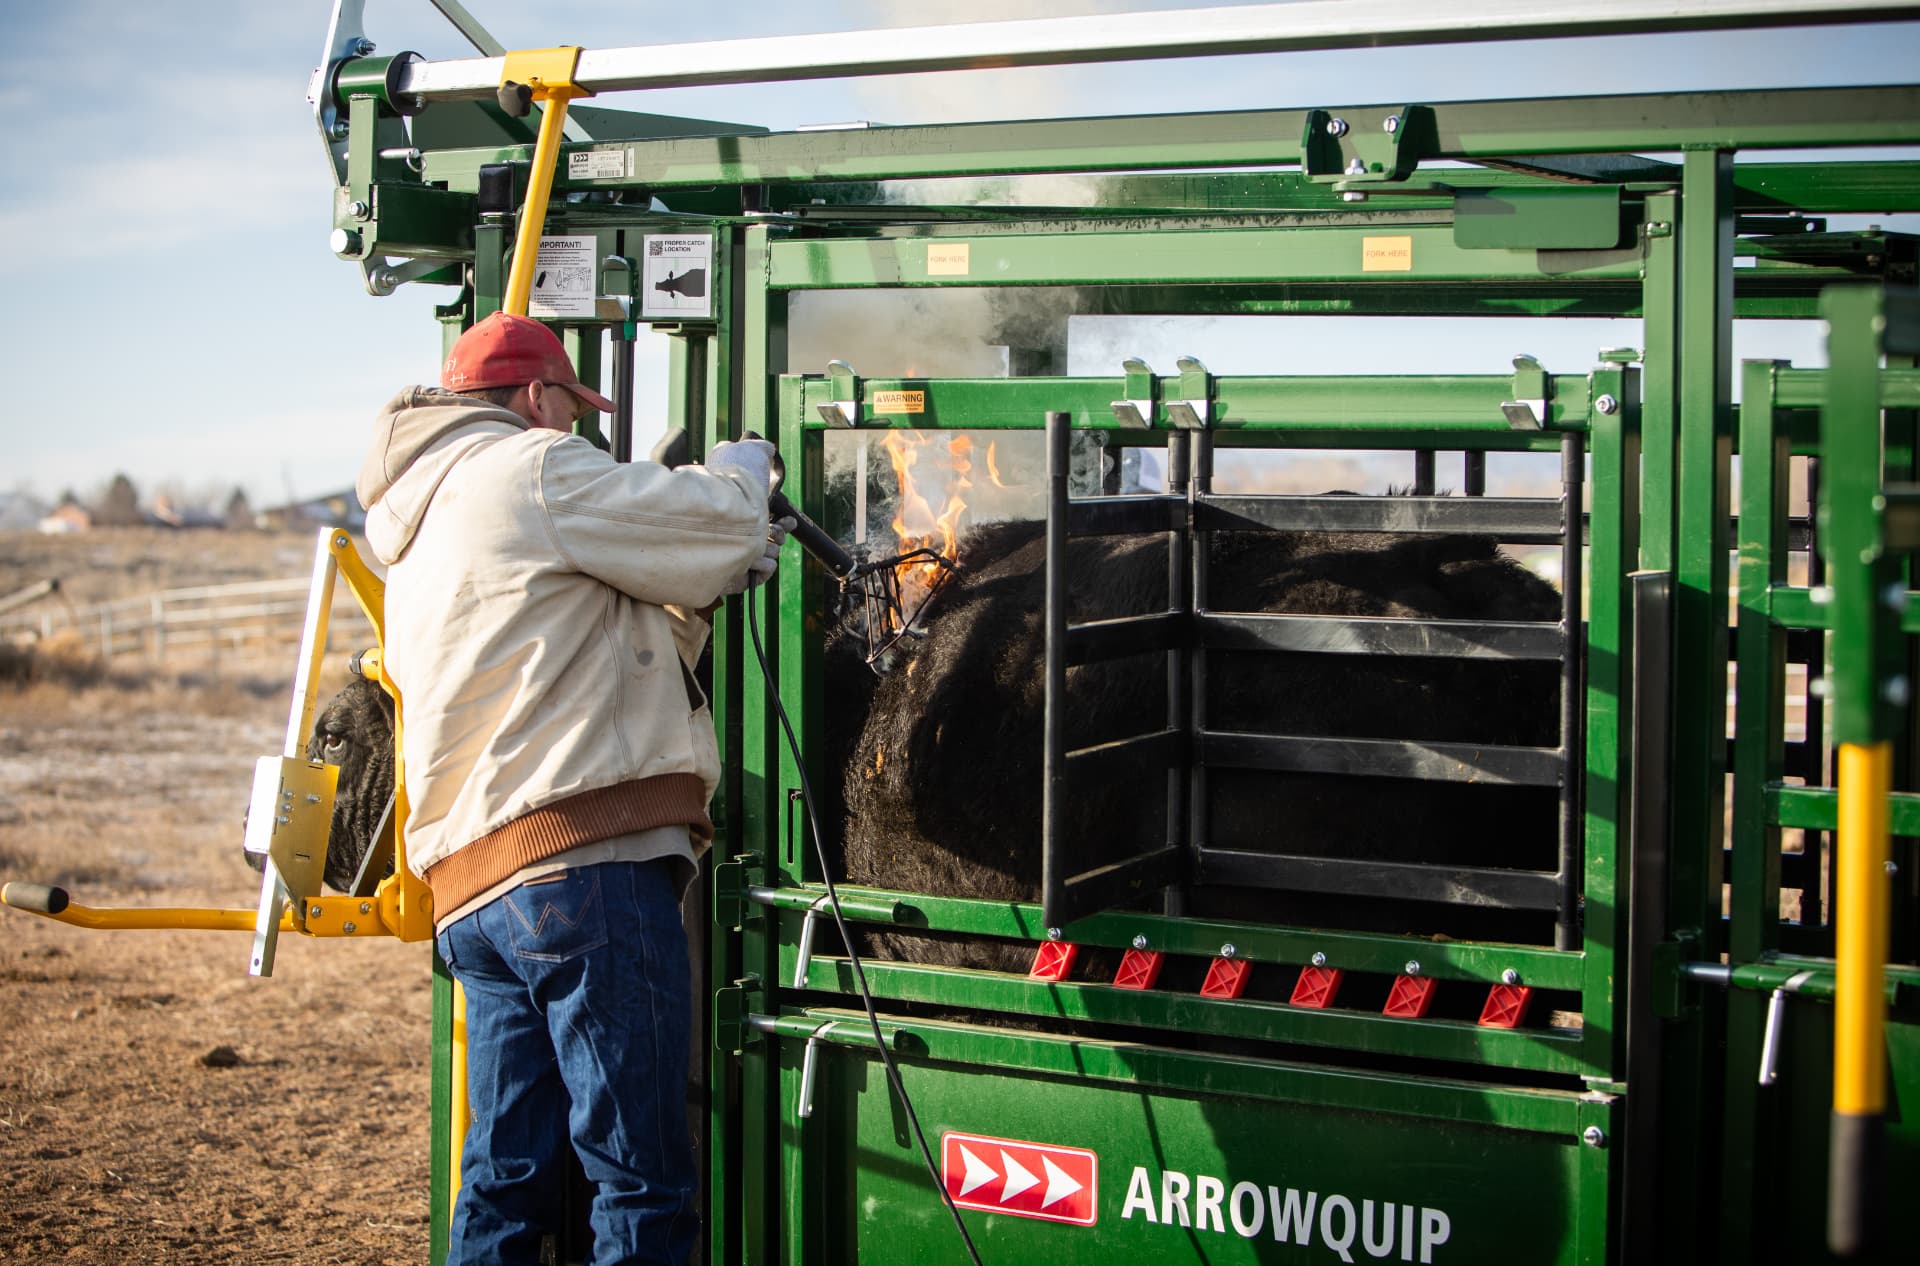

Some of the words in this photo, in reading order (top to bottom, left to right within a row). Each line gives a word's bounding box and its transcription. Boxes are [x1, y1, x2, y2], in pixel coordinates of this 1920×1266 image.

[538, 241, 582, 249] MPORTANT!
[1388, 249, 1408, 257] HERE
[883, 393, 923, 402] WARNING
[1120, 1165, 1451, 1265] ARROWQUIP
